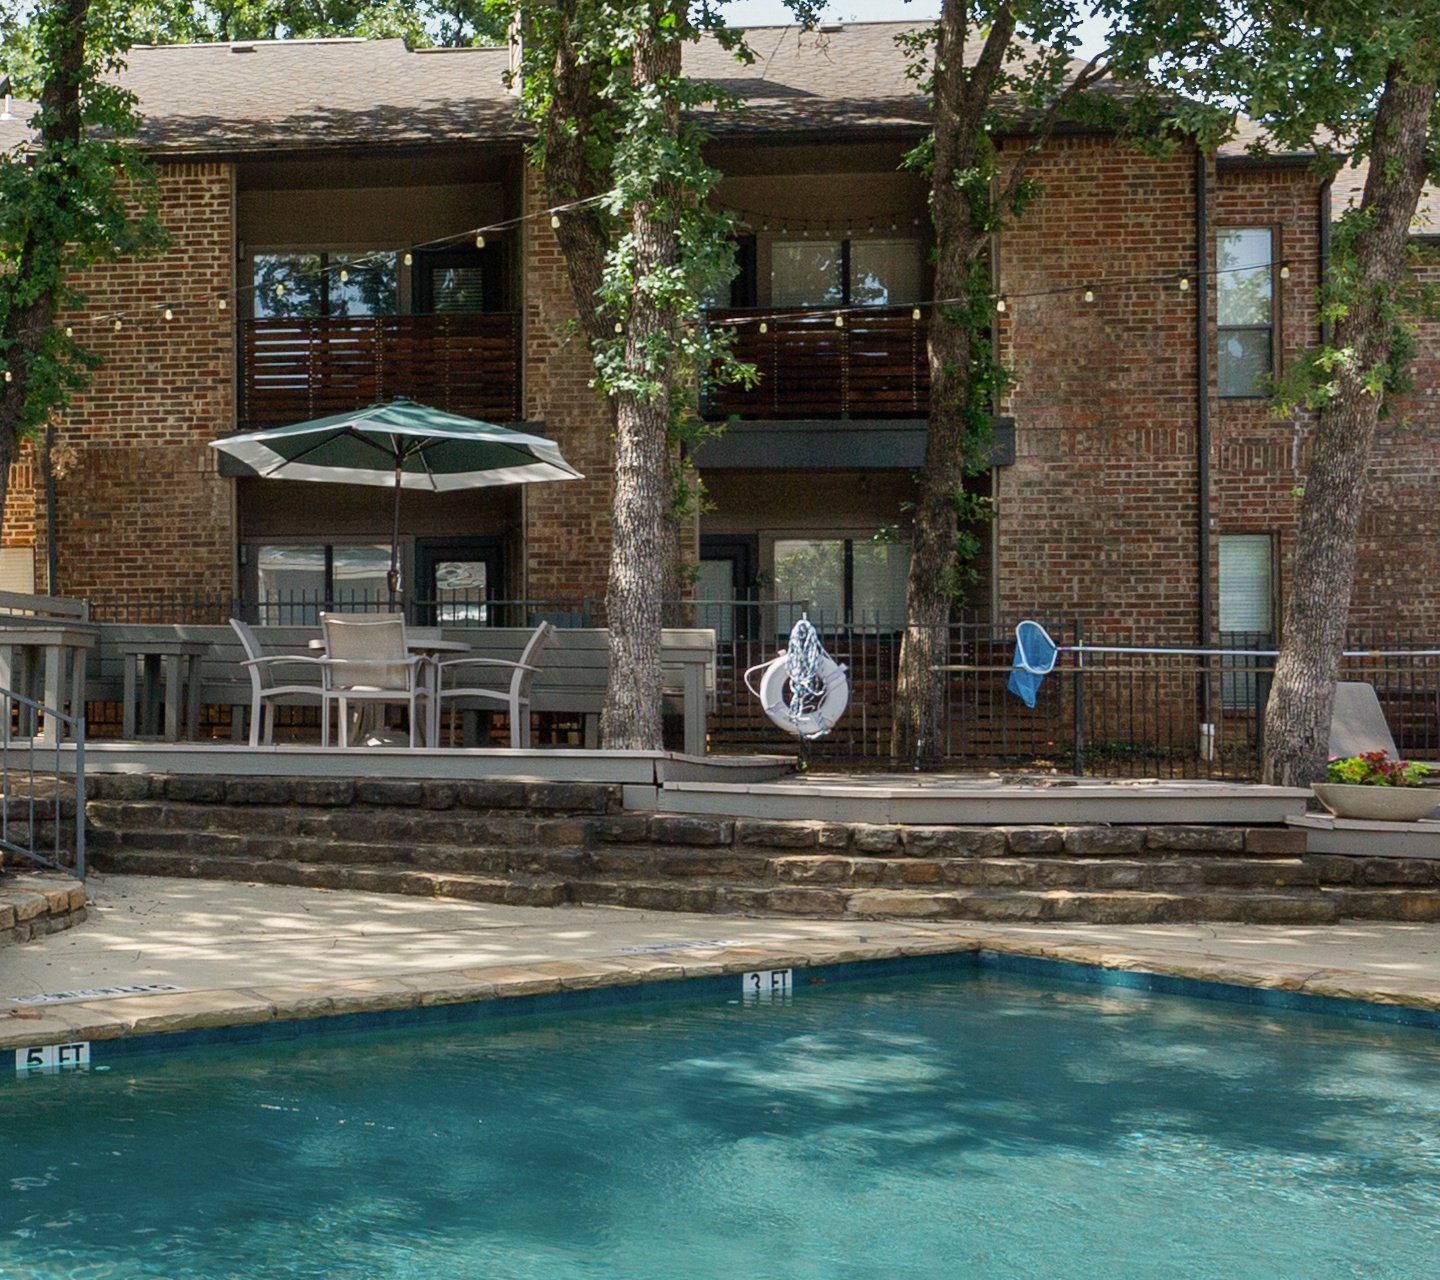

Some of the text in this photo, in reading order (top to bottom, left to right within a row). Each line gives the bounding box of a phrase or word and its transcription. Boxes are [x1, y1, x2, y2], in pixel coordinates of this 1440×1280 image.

[771, 970, 789, 988] FT
[26, 1044, 85, 1067] 5 FT
